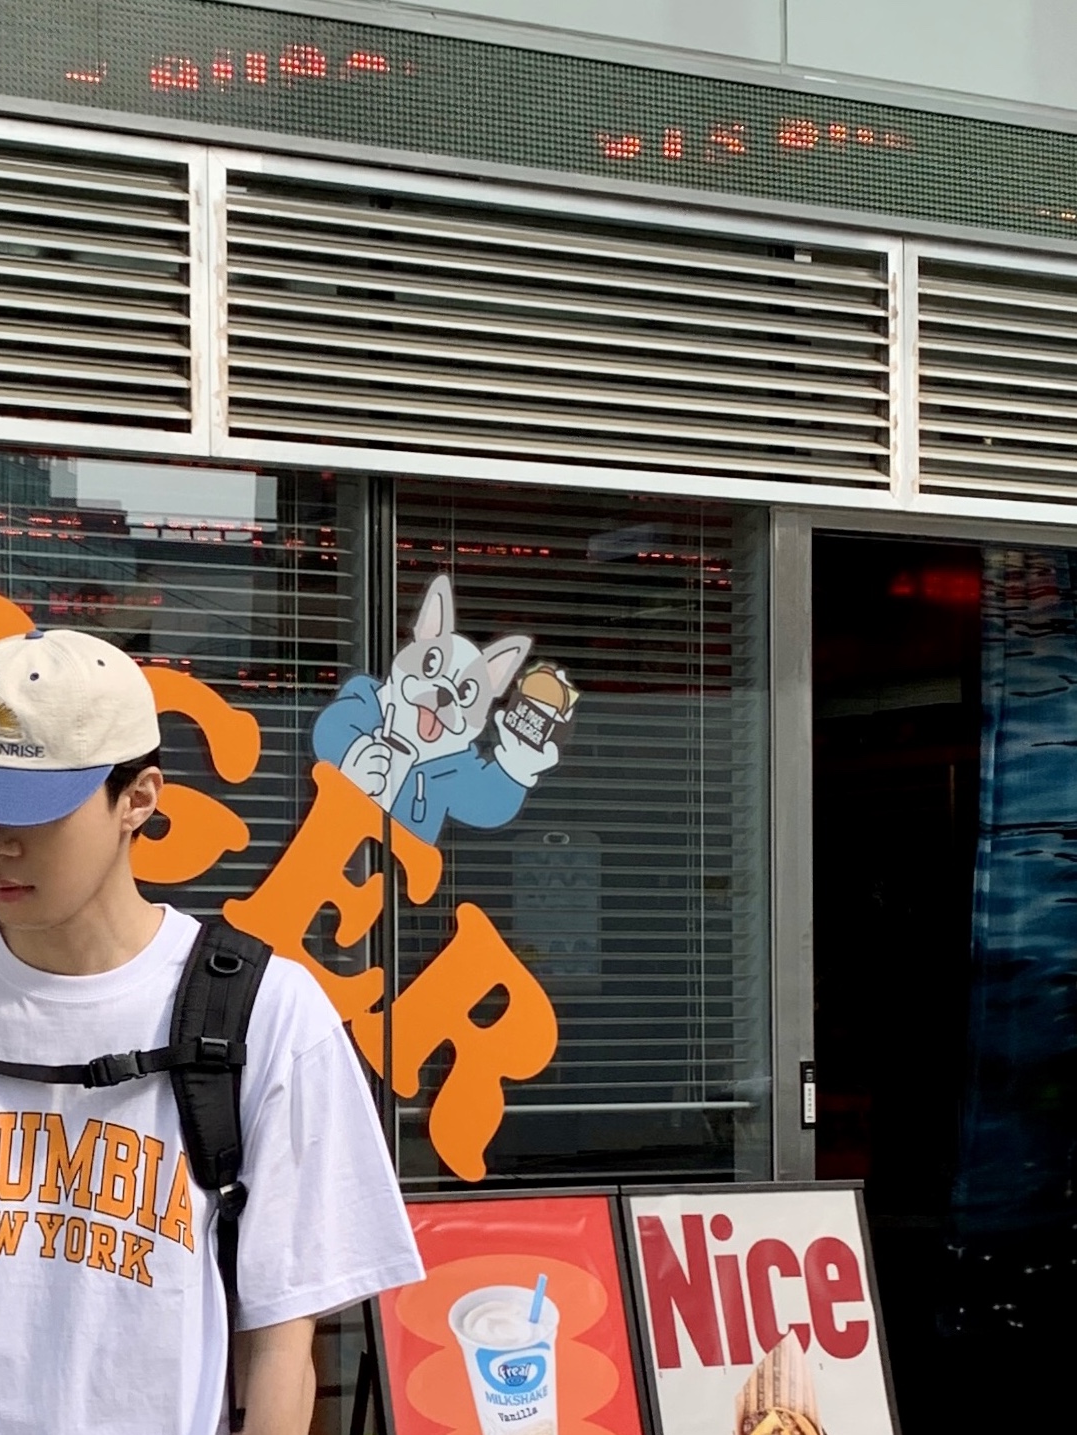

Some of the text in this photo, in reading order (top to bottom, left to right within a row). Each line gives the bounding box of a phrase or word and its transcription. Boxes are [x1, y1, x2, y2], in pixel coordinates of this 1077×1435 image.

[35, 1212, 155, 1288] YORK
[637, 1213, 870, 1369] Nice
[484, 1384, 548, 1407] MILKSHAKE
[498, 1406, 538, 1422] Vanilla
